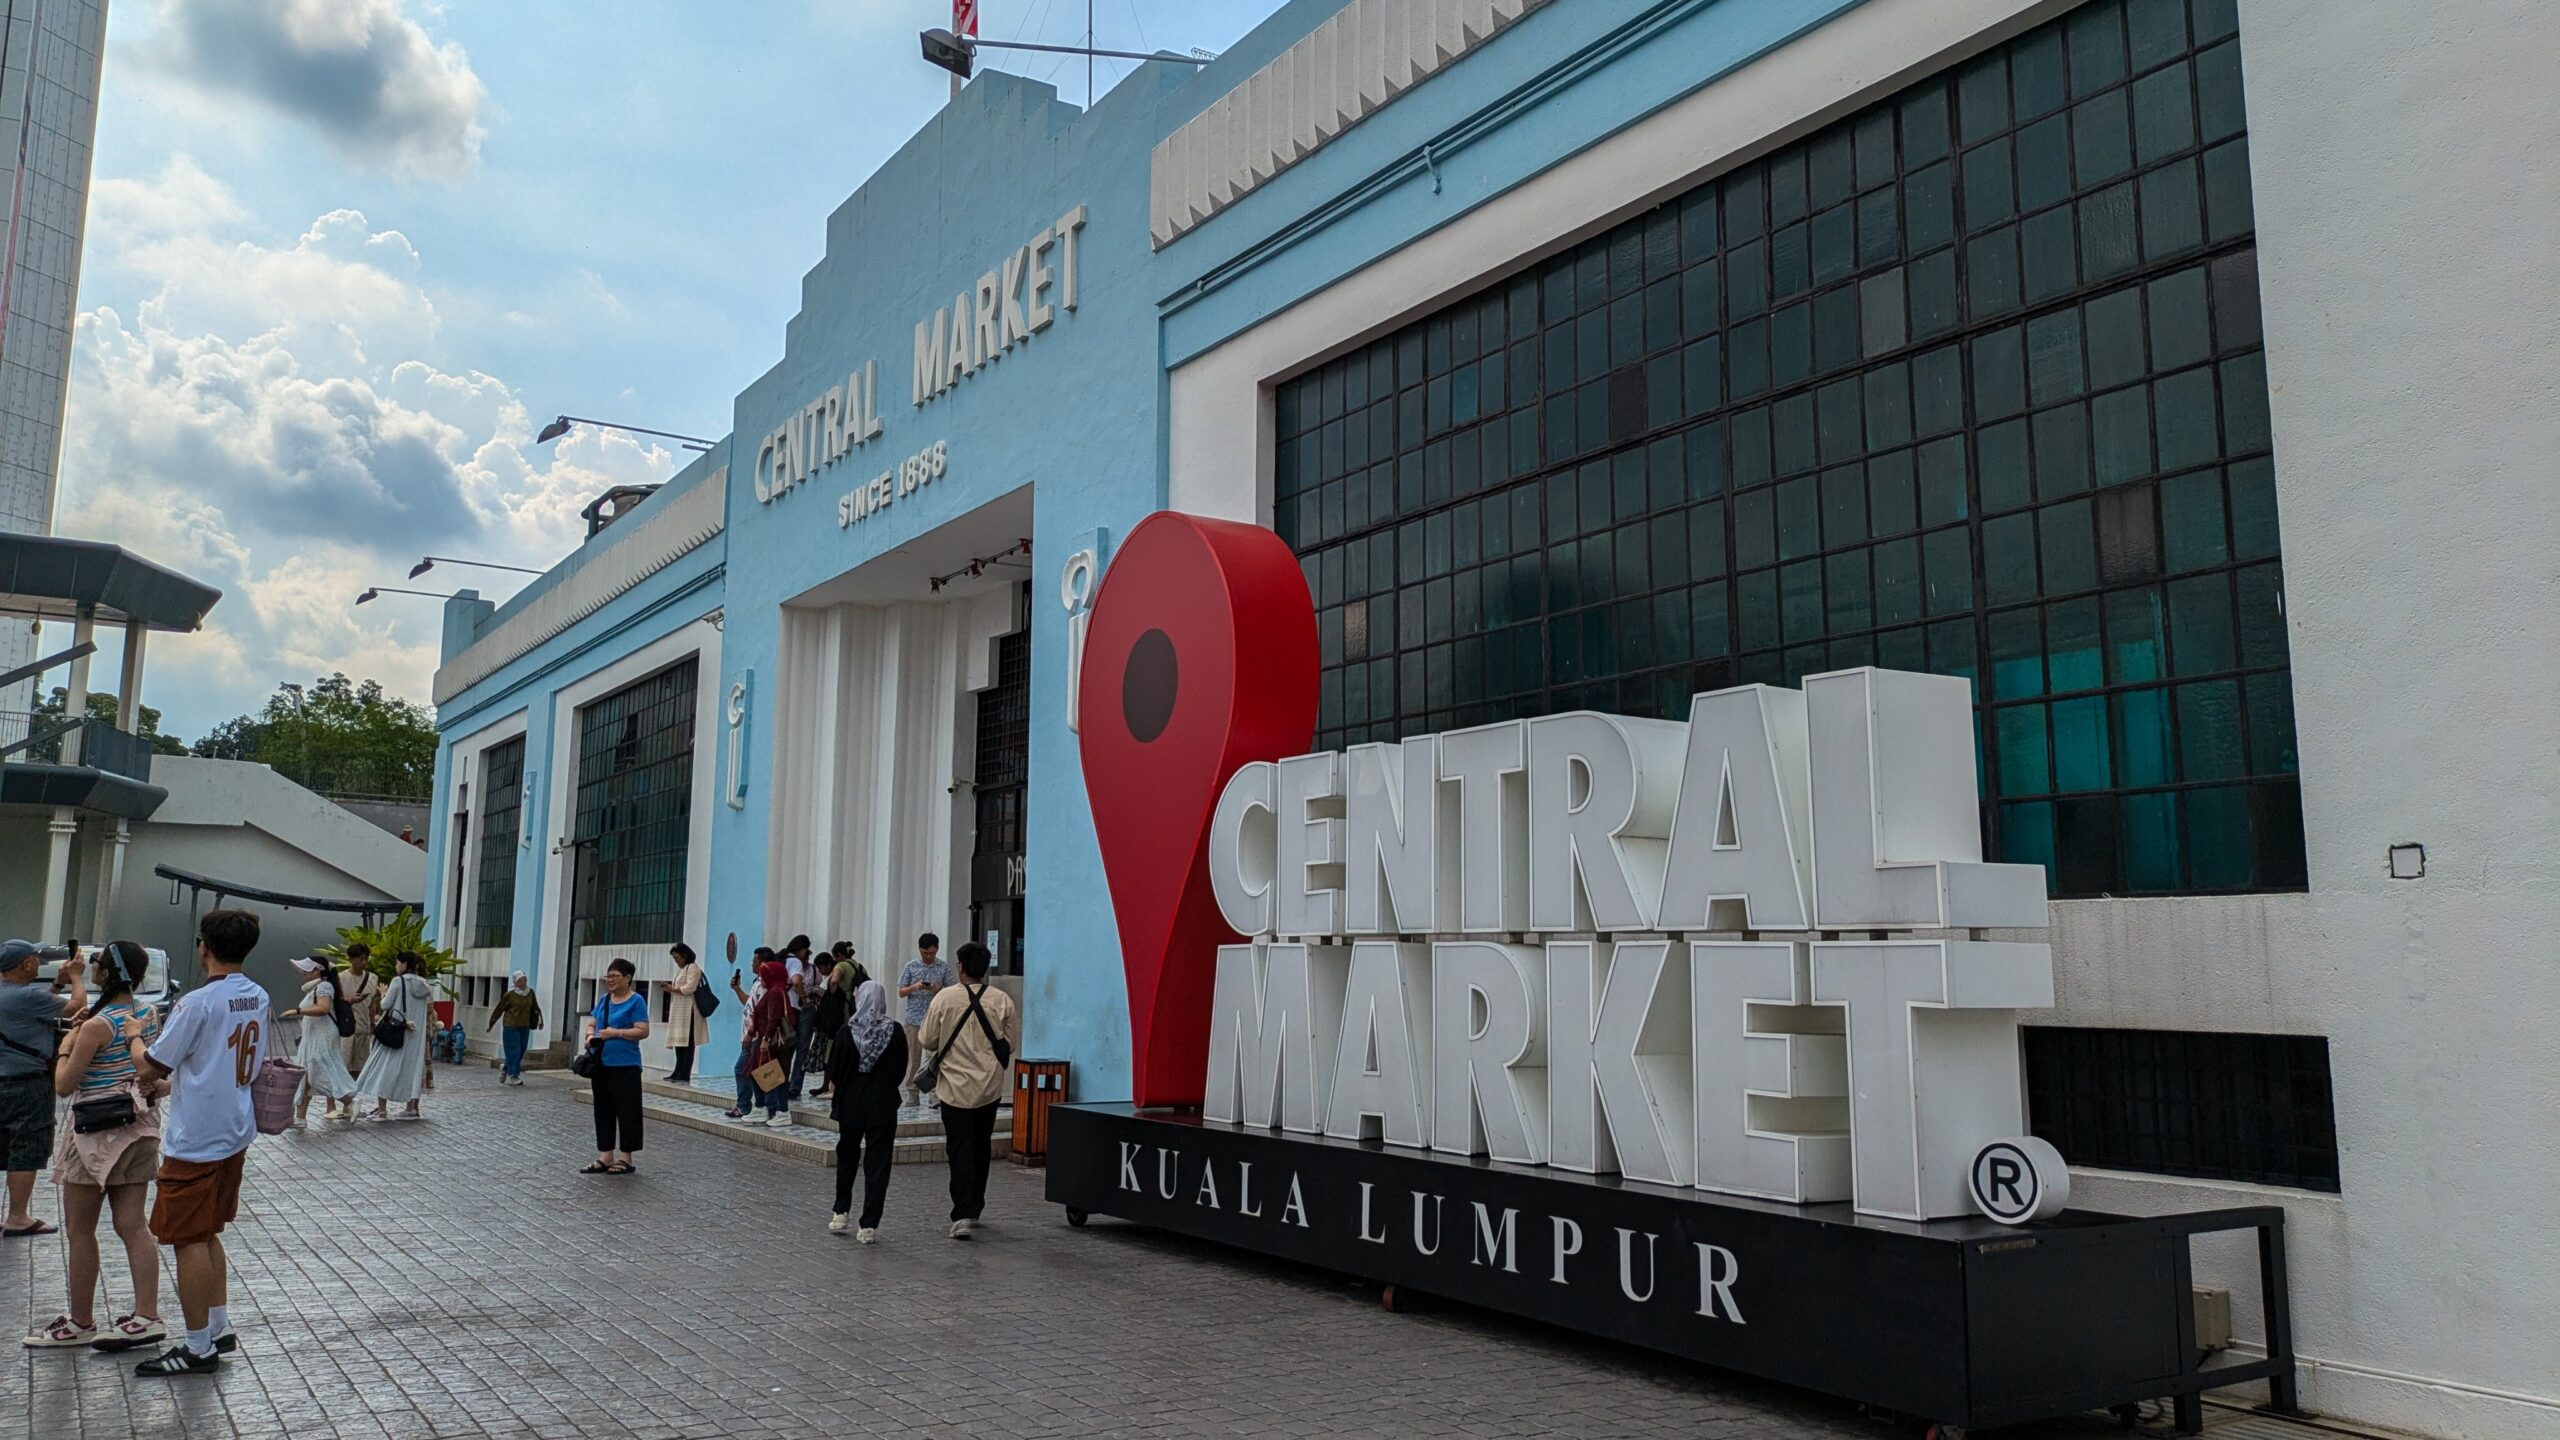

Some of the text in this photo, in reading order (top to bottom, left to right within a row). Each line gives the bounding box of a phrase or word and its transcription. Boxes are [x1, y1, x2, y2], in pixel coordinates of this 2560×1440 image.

[755, 204, 1087, 503] CENTRAL MARKET
[838, 440, 947, 528] SINCE 1888
[1208, 666, 1950, 937] CENTRAL
[227, 1020, 260, 1089] 16
[228, 996, 260, 1013] RODRIGO
[1203, 939, 1950, 1222] MARKET
[1118, 1141, 1748, 1325] KUALA LUMPUR
